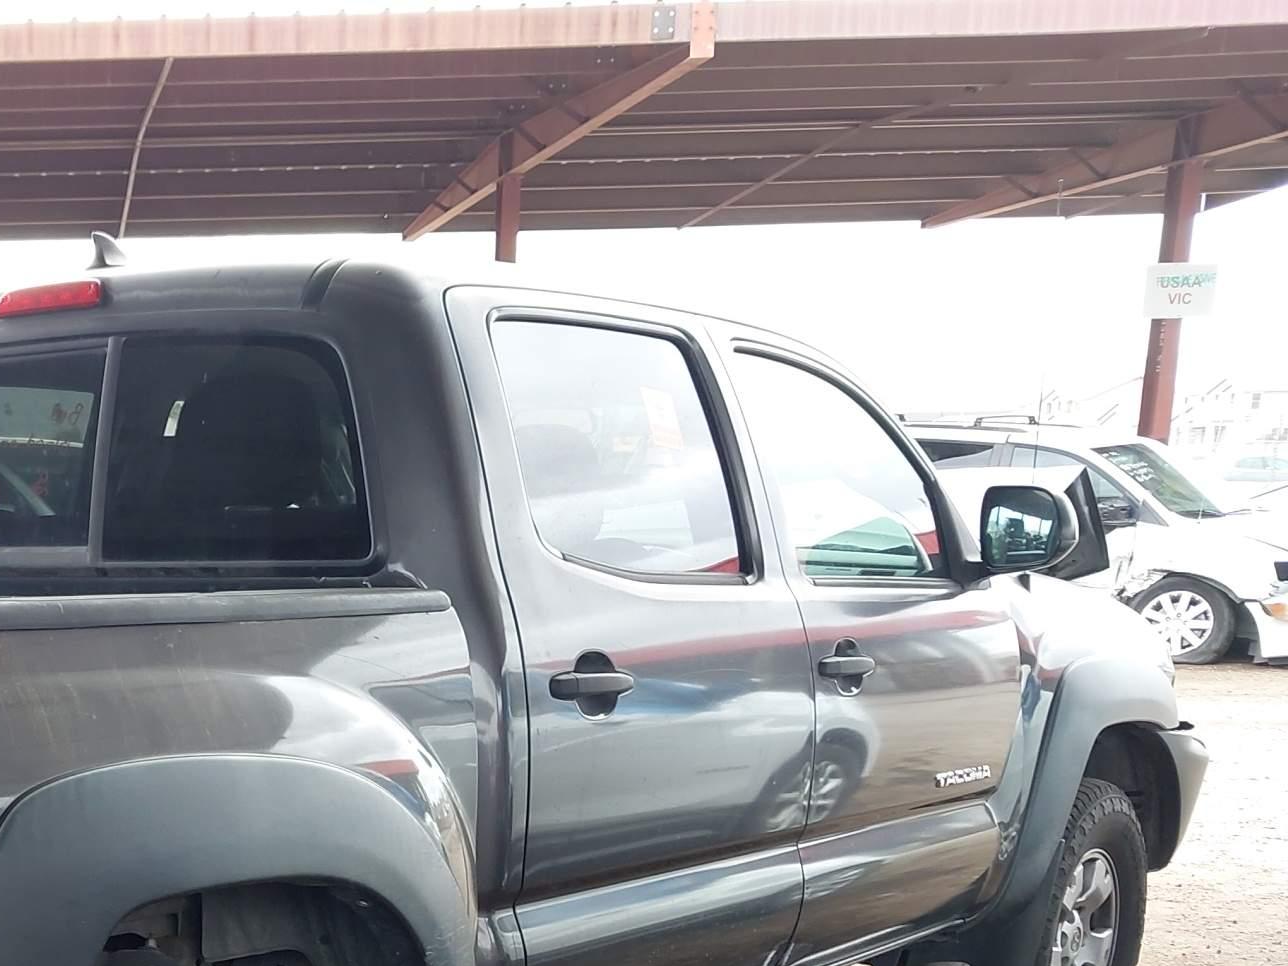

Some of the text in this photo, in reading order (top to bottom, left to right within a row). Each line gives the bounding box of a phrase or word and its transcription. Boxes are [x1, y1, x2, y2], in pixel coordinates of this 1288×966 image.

[1159, 275, 1203, 289] USAA
[1168, 292, 1192, 305] VIC
[934, 764, 991, 788] TACOMA
